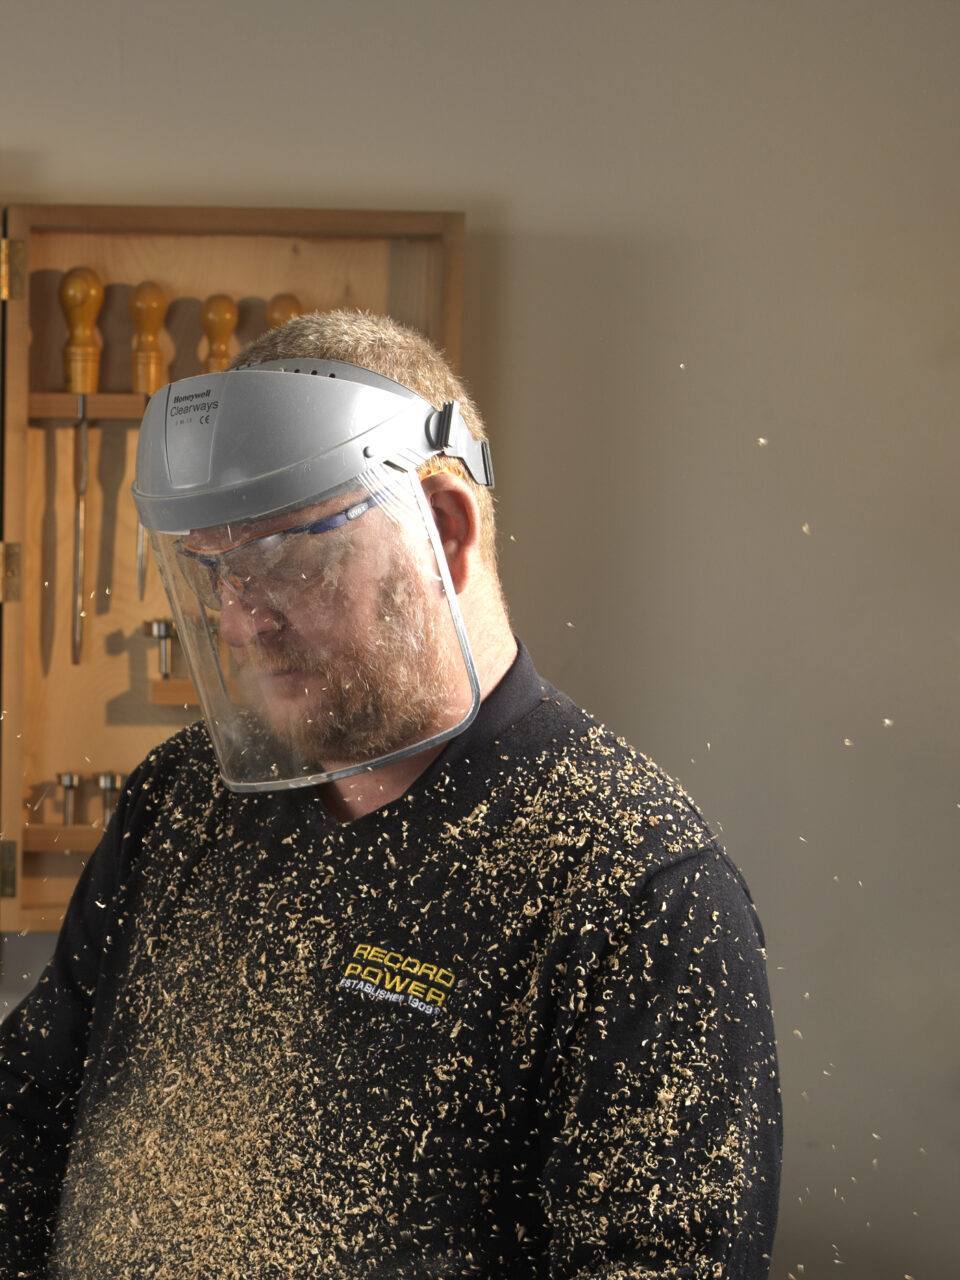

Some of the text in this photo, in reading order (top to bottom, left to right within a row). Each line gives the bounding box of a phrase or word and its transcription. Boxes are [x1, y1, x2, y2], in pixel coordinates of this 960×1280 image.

[170, 400, 219, 417] Clearways
[173, 389, 211, 404] Honeywell
[353, 943, 455, 988] RECORD
[344, 962, 446, 1007] POWER
